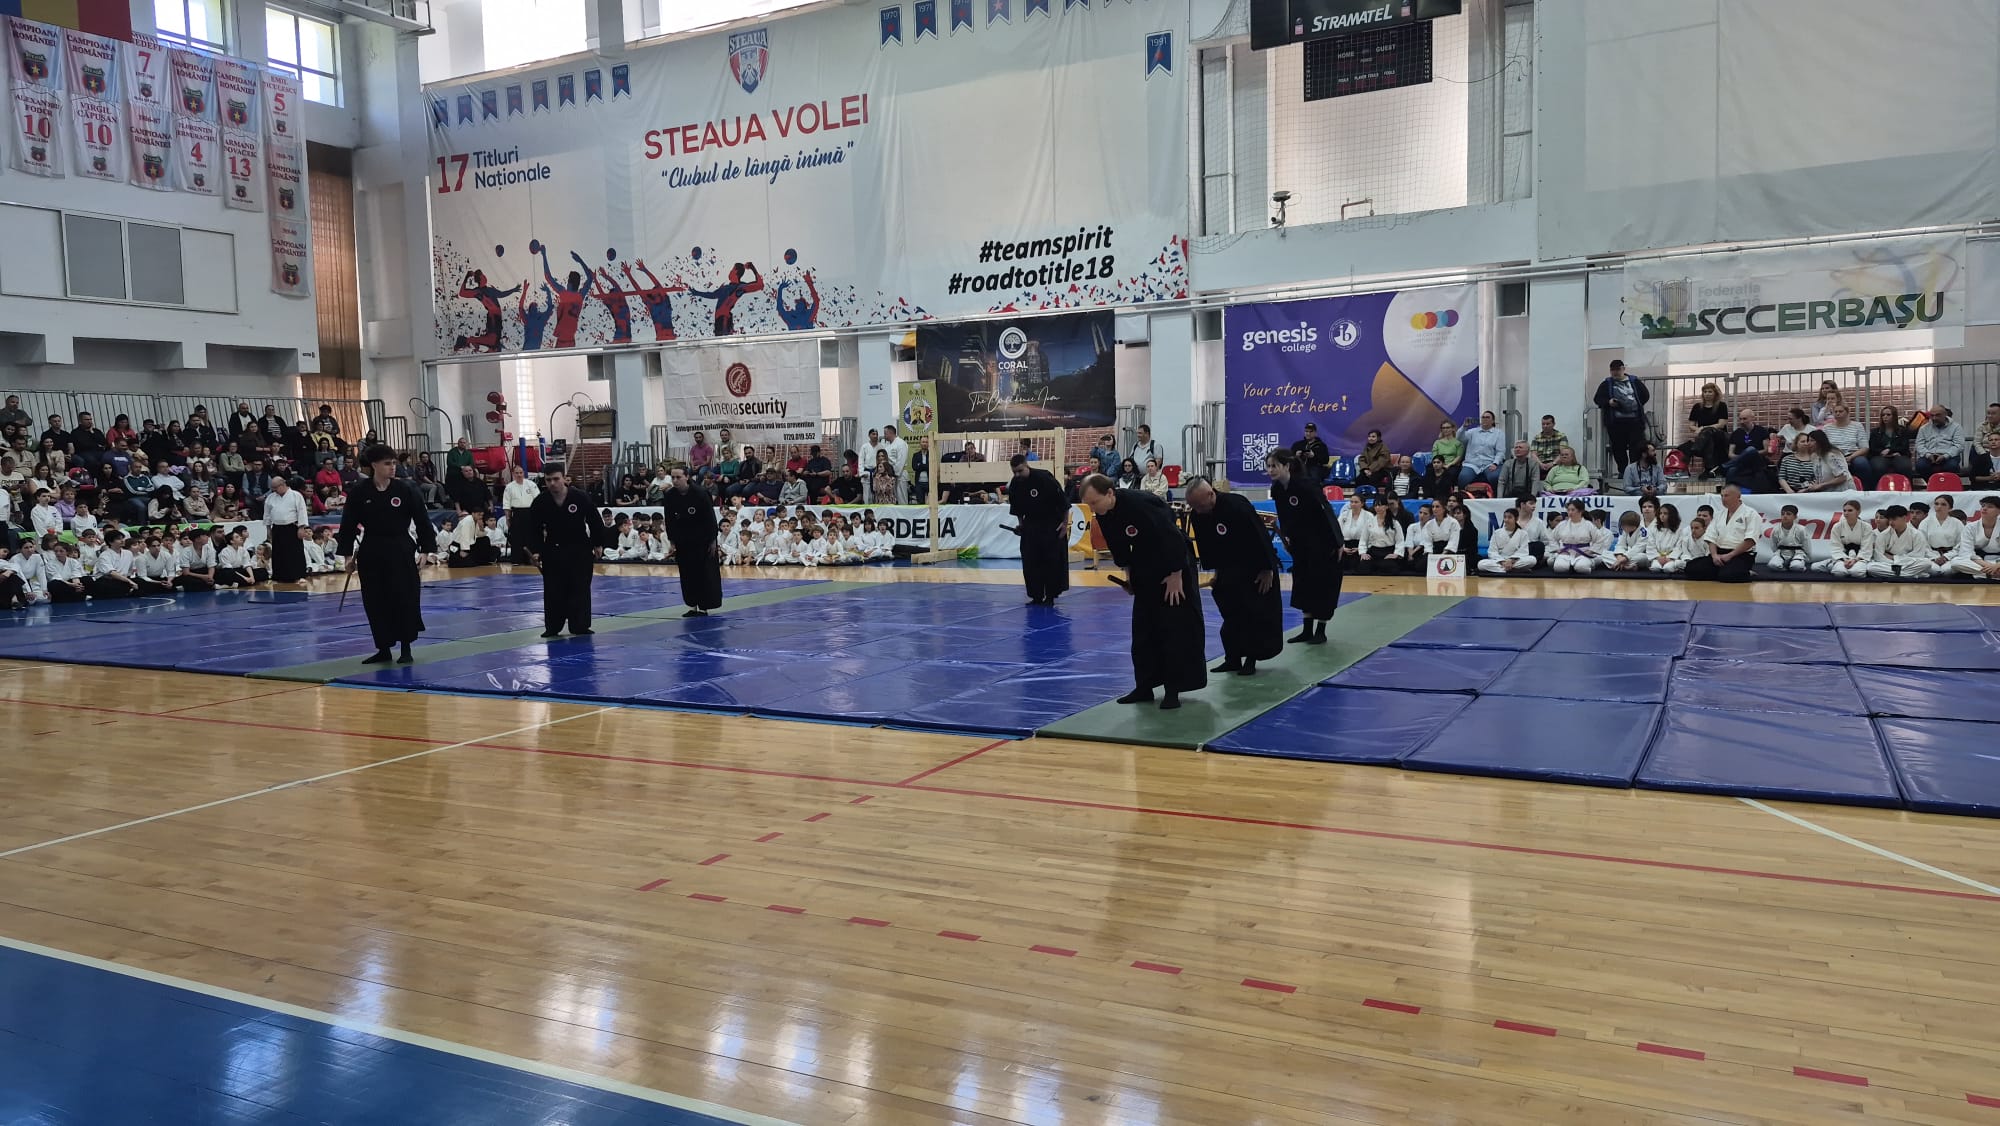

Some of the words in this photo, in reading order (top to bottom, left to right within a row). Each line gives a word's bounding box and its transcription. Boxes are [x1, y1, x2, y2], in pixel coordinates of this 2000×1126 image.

[1312, 4, 1392, 33] STRAMATEL
[66, 35, 116, 52] CAMPIOANA
[728, 30, 768, 51] STEAUA
[138, 50, 151, 72] 7
[80, 102, 112, 115] VIRGIL
[274, 92, 286, 112] 5
[23, 114, 51, 138] 10
[83, 121, 113, 146] 10
[644, 113, 767, 160] STEAUA
[771, 93, 869, 138] VOLEI
[190, 142, 203, 162] 4
[225, 138, 255, 150] ARMAND
[228, 155, 251, 177] 13
[473, 145, 519, 169] Titluri
[436, 153, 470, 194] 17
[475, 162, 551, 191] Naționale
[721, 157, 742, 180] de
[979, 225, 1114, 263] #teamspirit
[948, 255, 1115, 295] #roadtotitle18
[1242, 321, 1318, 351] genesis
[1281, 343, 1316, 353] college
[998, 360, 1028, 370] CORAL
[1242, 383, 1272, 399] Your
[1275, 382, 1310, 398] story
[1260, 400, 1304, 415] starts
[1309, 395, 1347, 413] here!
